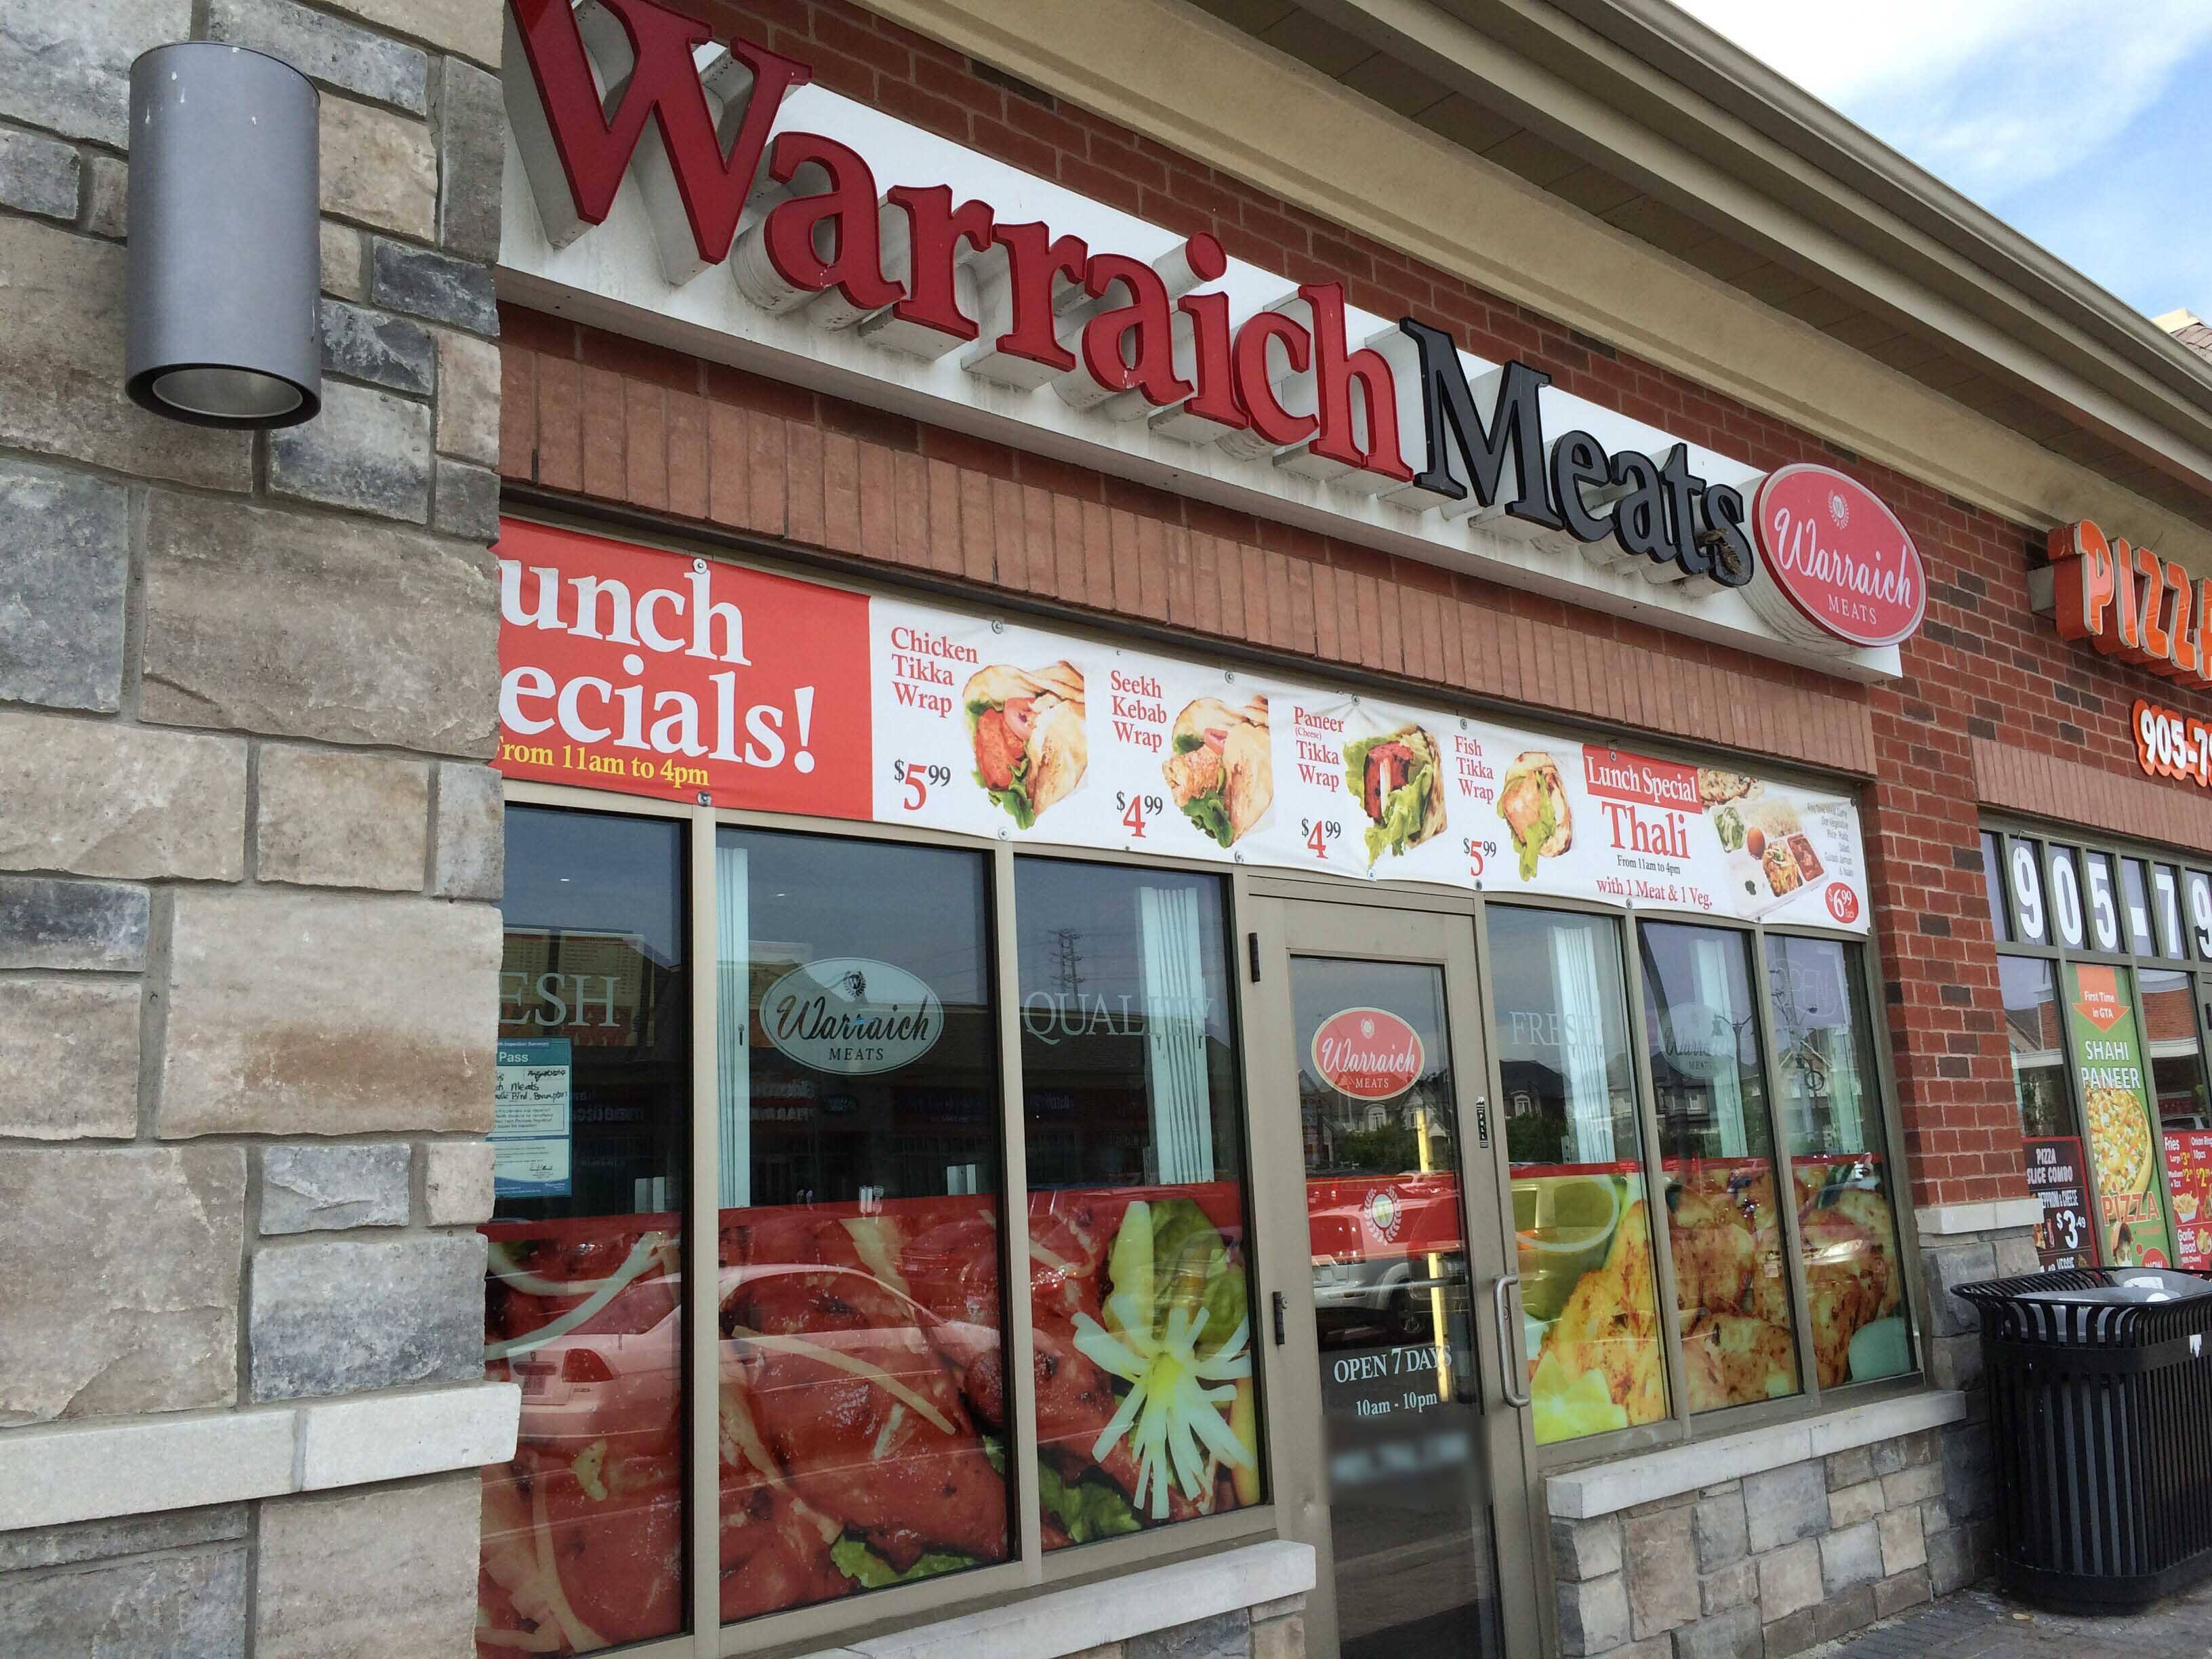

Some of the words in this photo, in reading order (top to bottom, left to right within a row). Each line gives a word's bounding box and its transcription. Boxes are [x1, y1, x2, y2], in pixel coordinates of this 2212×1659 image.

[513, 0, 1414, 482] Warraich
[1398, 314, 1754, 587] Meats
[1774, 507, 1912, 609] Warraich
[499, 558, 752, 667] unch
[1828, 594, 1878, 626] MEATS
[891, 626, 979, 664] Chicken
[892, 654, 954, 686] Tikka
[1110, 670, 1163, 699] Seekh
[499, 653, 816, 774] ecials!
[893, 681, 953, 718] Wrap
[1111, 695, 1167, 724] Kebab
[1293, 706, 1345, 733] Paneer
[1295, 726, 1322, 741] (Cheese)
[1113, 720, 1163, 753] Wrap
[1454, 735, 1482, 757] Fish
[2140, 709, 2212, 776] 905-7
[498, 736, 554, 766] rom
[562, 745, 626, 775] 11am
[631, 756, 655, 779] to
[660, 758, 710, 788] 4pm
[1296, 740, 1340, 765] Tikka
[1297, 764, 1339, 793] Wrap
[1456, 756, 1494, 779] Tikka
[1585, 755, 1641, 792] Lunch
[1643, 767, 1698, 803] Special
[1458, 779, 1494, 804] Wrap
[1601, 801, 1691, 859] Thali
[1617, 854, 1636, 867] From
[1638, 858, 1656, 872] 11am
[1657, 862, 1665, 874] to
[1666, 862, 1681, 876] 4pm
[1597, 878, 1625, 896] with
[1626, 879, 1633, 897] 1
[1635, 881, 1666, 901] Meat
[1668, 884, 1677, 902] &
[1681, 886, 1686, 903] 1
[1689, 887, 1713, 910] Veg.
[498, 971, 621, 1027] ESH
[2084, 991, 2098, 1002] First
[2099, 991, 2115, 1003] Time
[777, 994, 930, 1041] Warraich
[2093, 1008, 2099, 1017] in
[2100, 1008, 2114, 1019] GTA
[499, 1051, 529, 1063] Pass
[829, 1047, 884, 1061] MEATS
[1322, 1035, 1416, 1073] Warraich
[2085, 1040, 2129, 1061] SHAHI
[1355, 1078, 1389, 1088] MEATS
[2081, 1067, 2142, 1089] PANEER
[2036, 1147, 2057, 1166] PIZZA
[2165, 1136, 2180, 1151] Fries
[2026, 1166, 2047, 1185] SLICE
[2047, 1166, 2074, 1183] COMBO
[2062, 1189, 2079, 1207] CHEESE
[2101, 1184, 2161, 1226] PIZZA
[2177, 1227, 2195, 1242] Garlic
[2179, 1240, 2196, 1254] Bread
[1334, 1354, 1387, 1383] OPEN
[1391, 1347, 1401, 1374] 7
[1404, 1345, 1452, 1372] DAYS
[1355, 1399, 1391, 1415] 10am
[1403, 1391, 1438, 1412] 10pm
